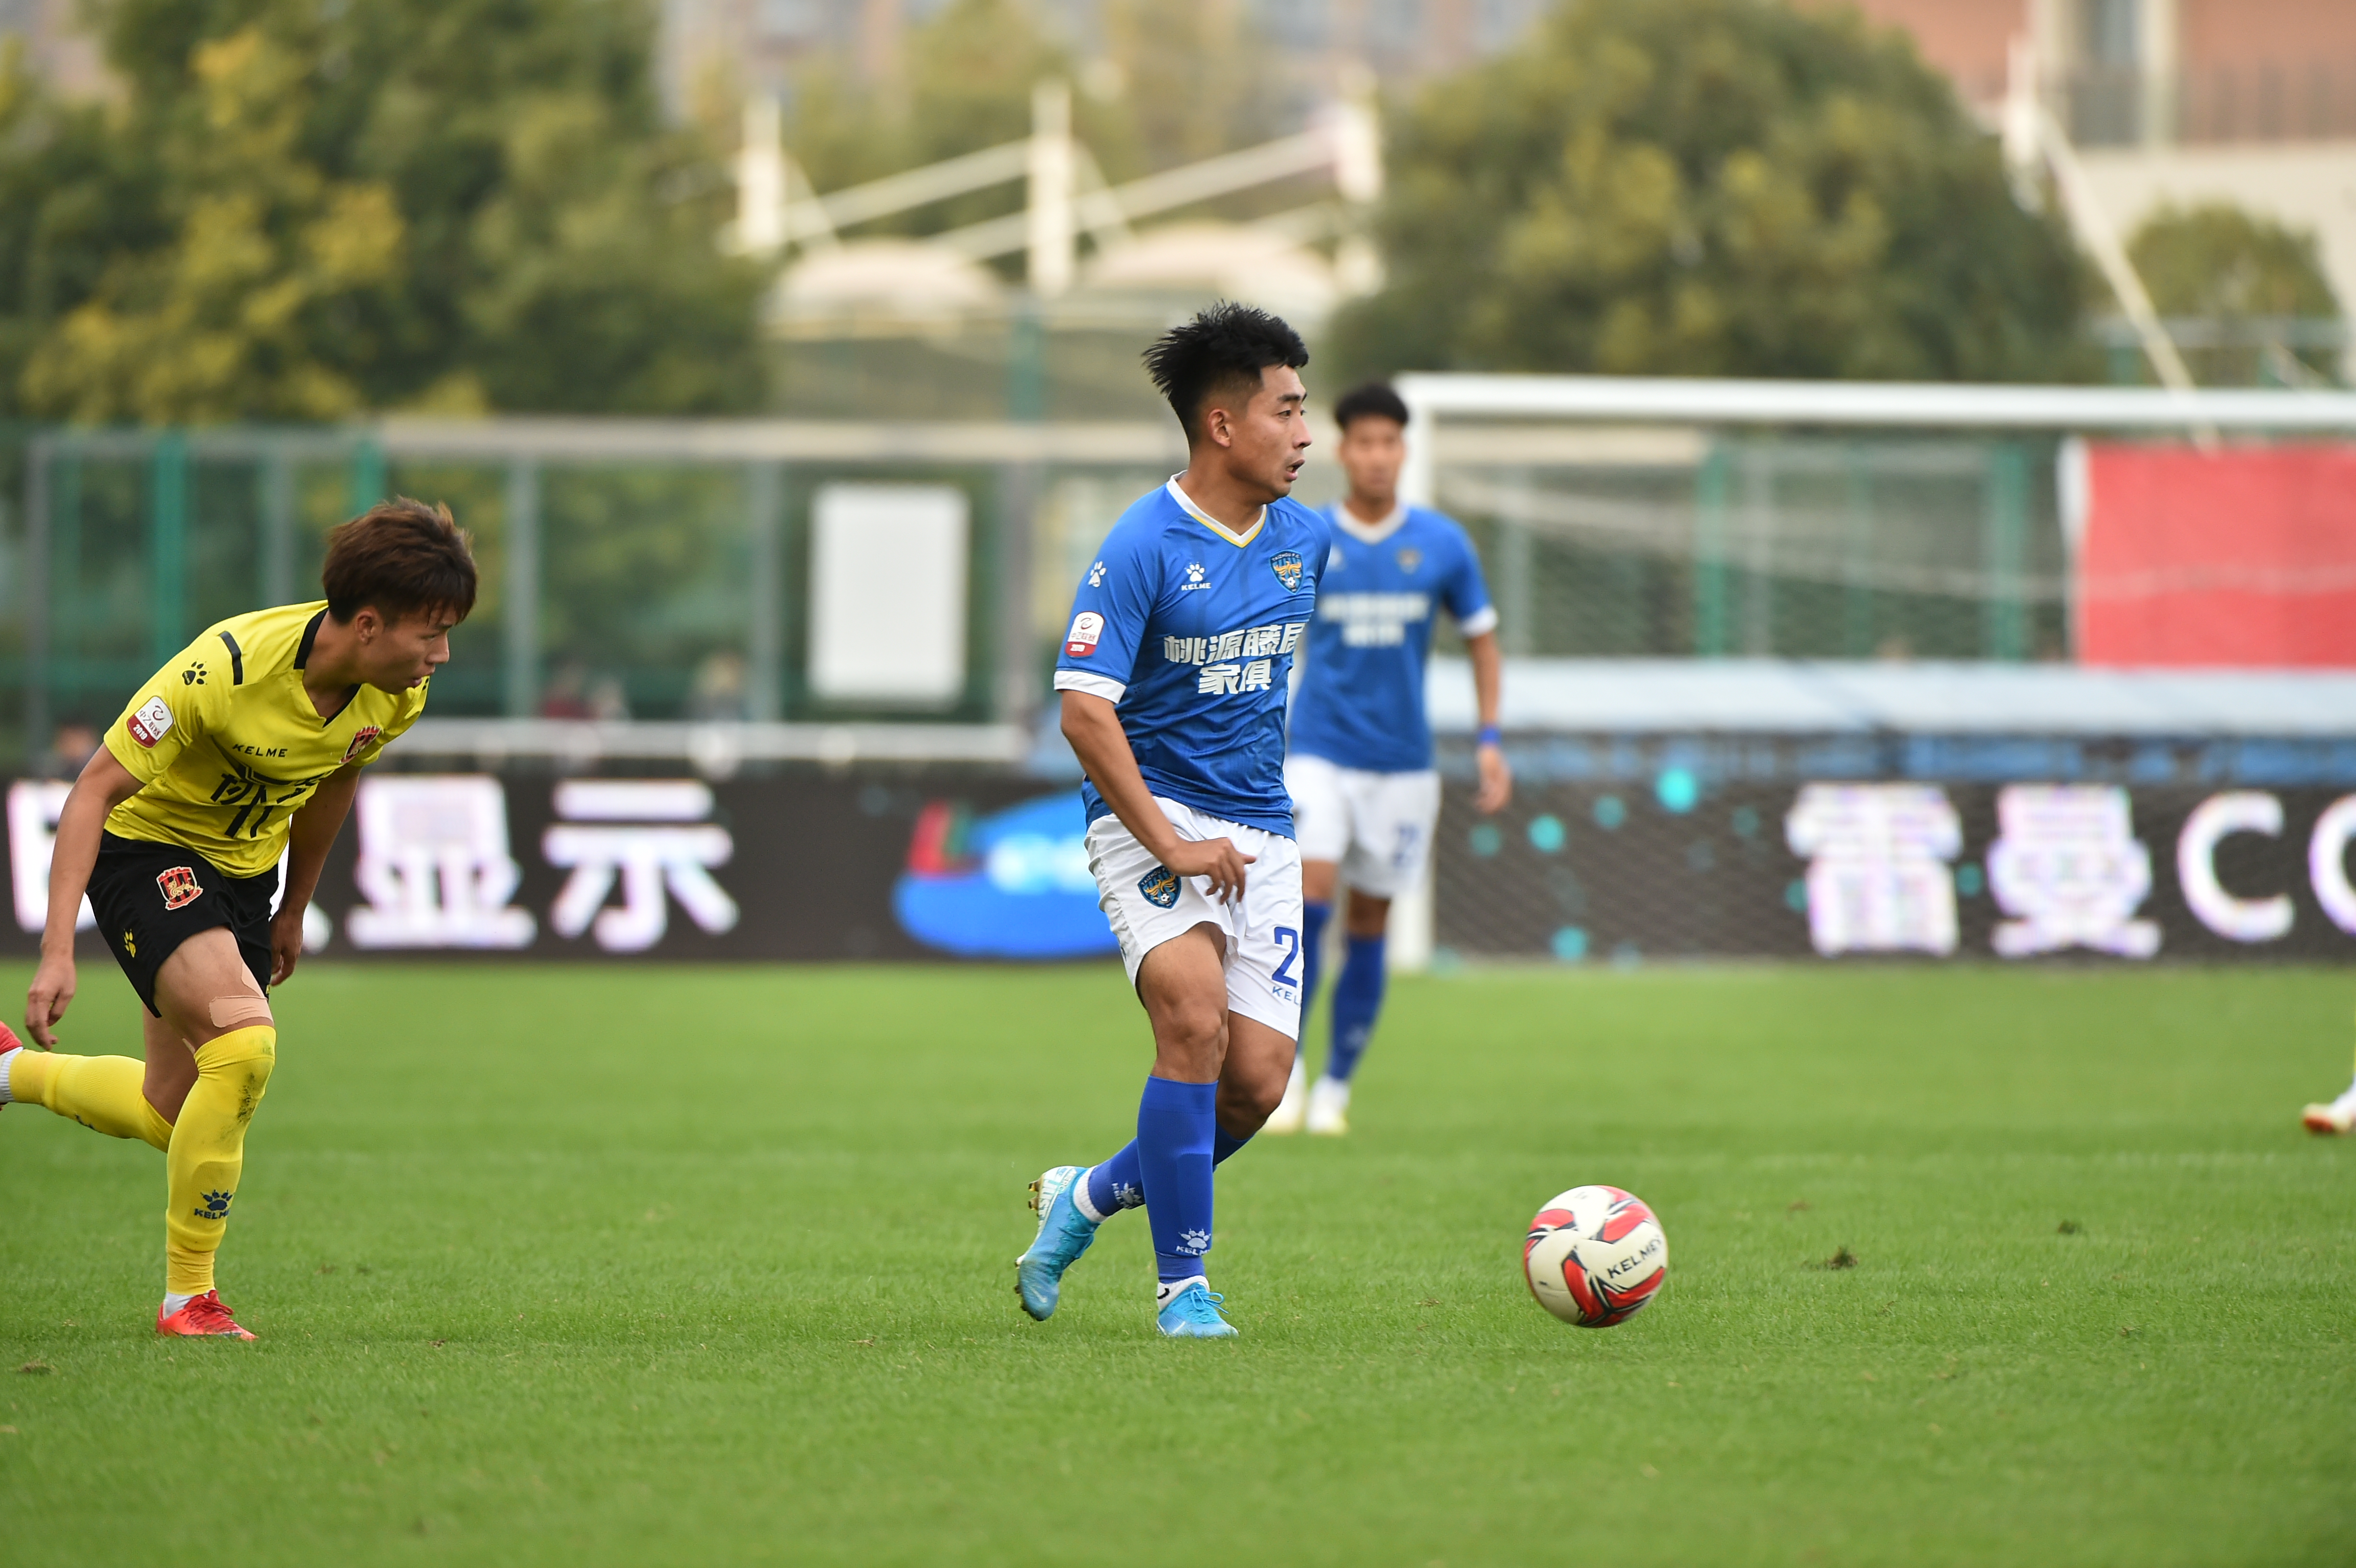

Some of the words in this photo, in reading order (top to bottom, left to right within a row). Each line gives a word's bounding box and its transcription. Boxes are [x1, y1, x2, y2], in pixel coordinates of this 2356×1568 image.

[1181, 582, 1212, 591] KELME
[133, 724, 148, 740] 2019
[232, 743, 288, 757] KELME
